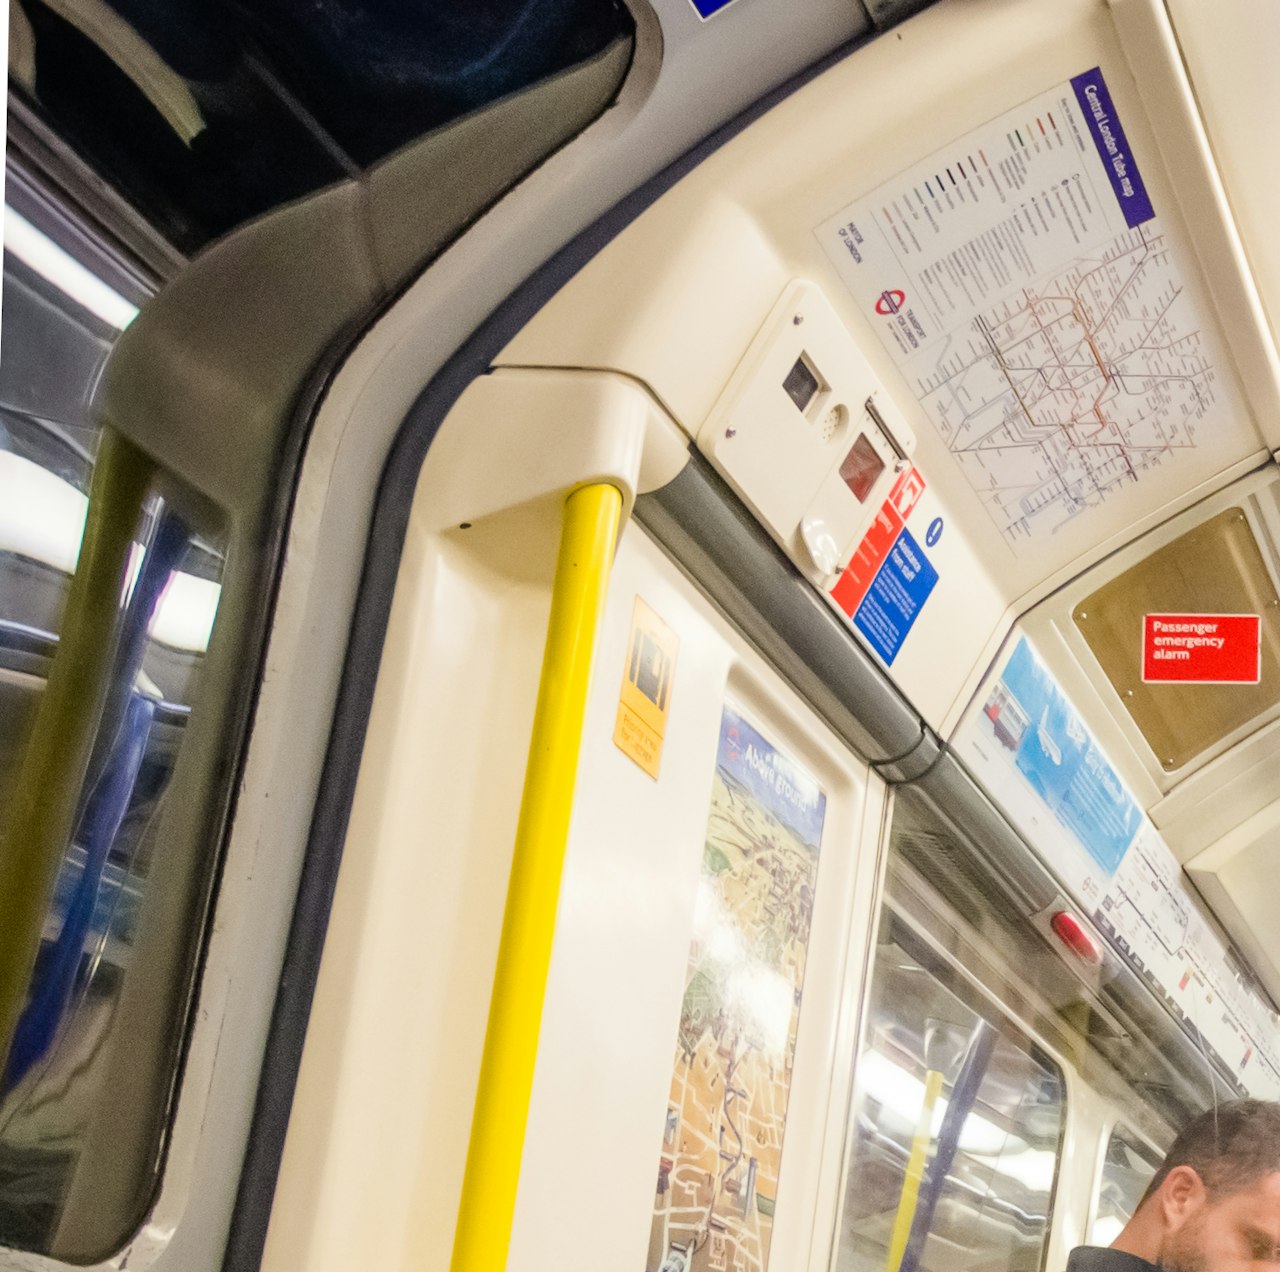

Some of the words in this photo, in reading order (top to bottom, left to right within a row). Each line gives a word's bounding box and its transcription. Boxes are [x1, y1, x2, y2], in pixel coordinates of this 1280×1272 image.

[1085, 84, 1108, 122] Central
[1098, 119, 1118, 155] London
[1112, 153, 1126, 177] Tube
[1121, 177, 1134, 197] map
[1153, 621, 1218, 635] Passenger
[1154, 637, 1225, 649] emergency
[1153, 649, 1190, 660] alarm
